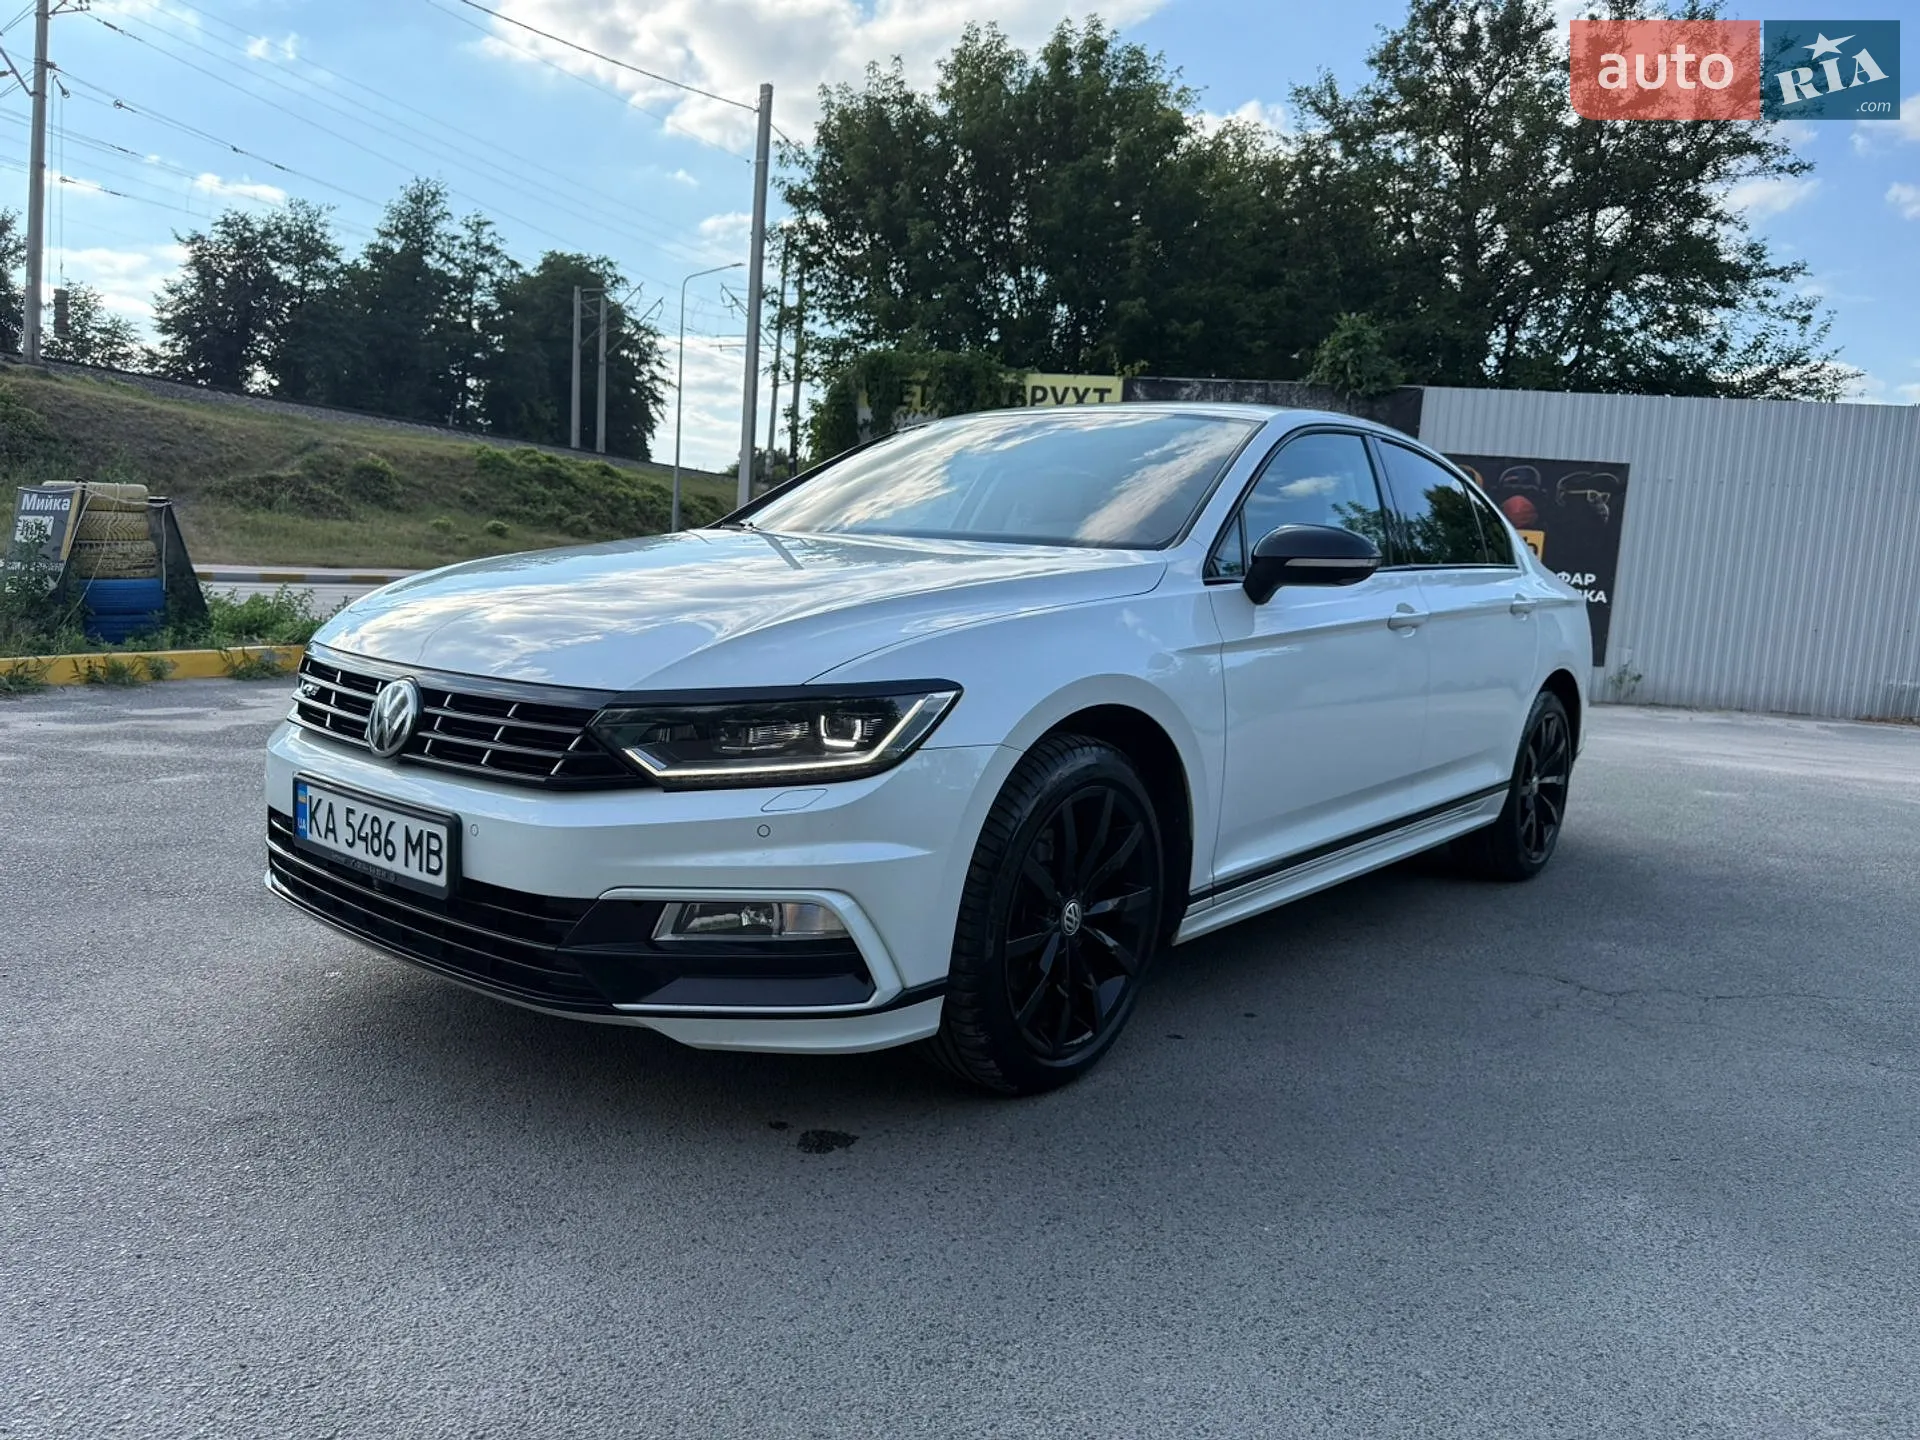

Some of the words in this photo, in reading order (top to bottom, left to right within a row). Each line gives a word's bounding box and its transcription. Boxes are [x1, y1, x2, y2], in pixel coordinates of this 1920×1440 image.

[21, 493, 71, 511] Мийка
[1577, 589, 1607, 603] КА
[308, 795, 338, 844] KA
[345, 806, 396, 862] 5486
[404, 824, 444, 876] MB
